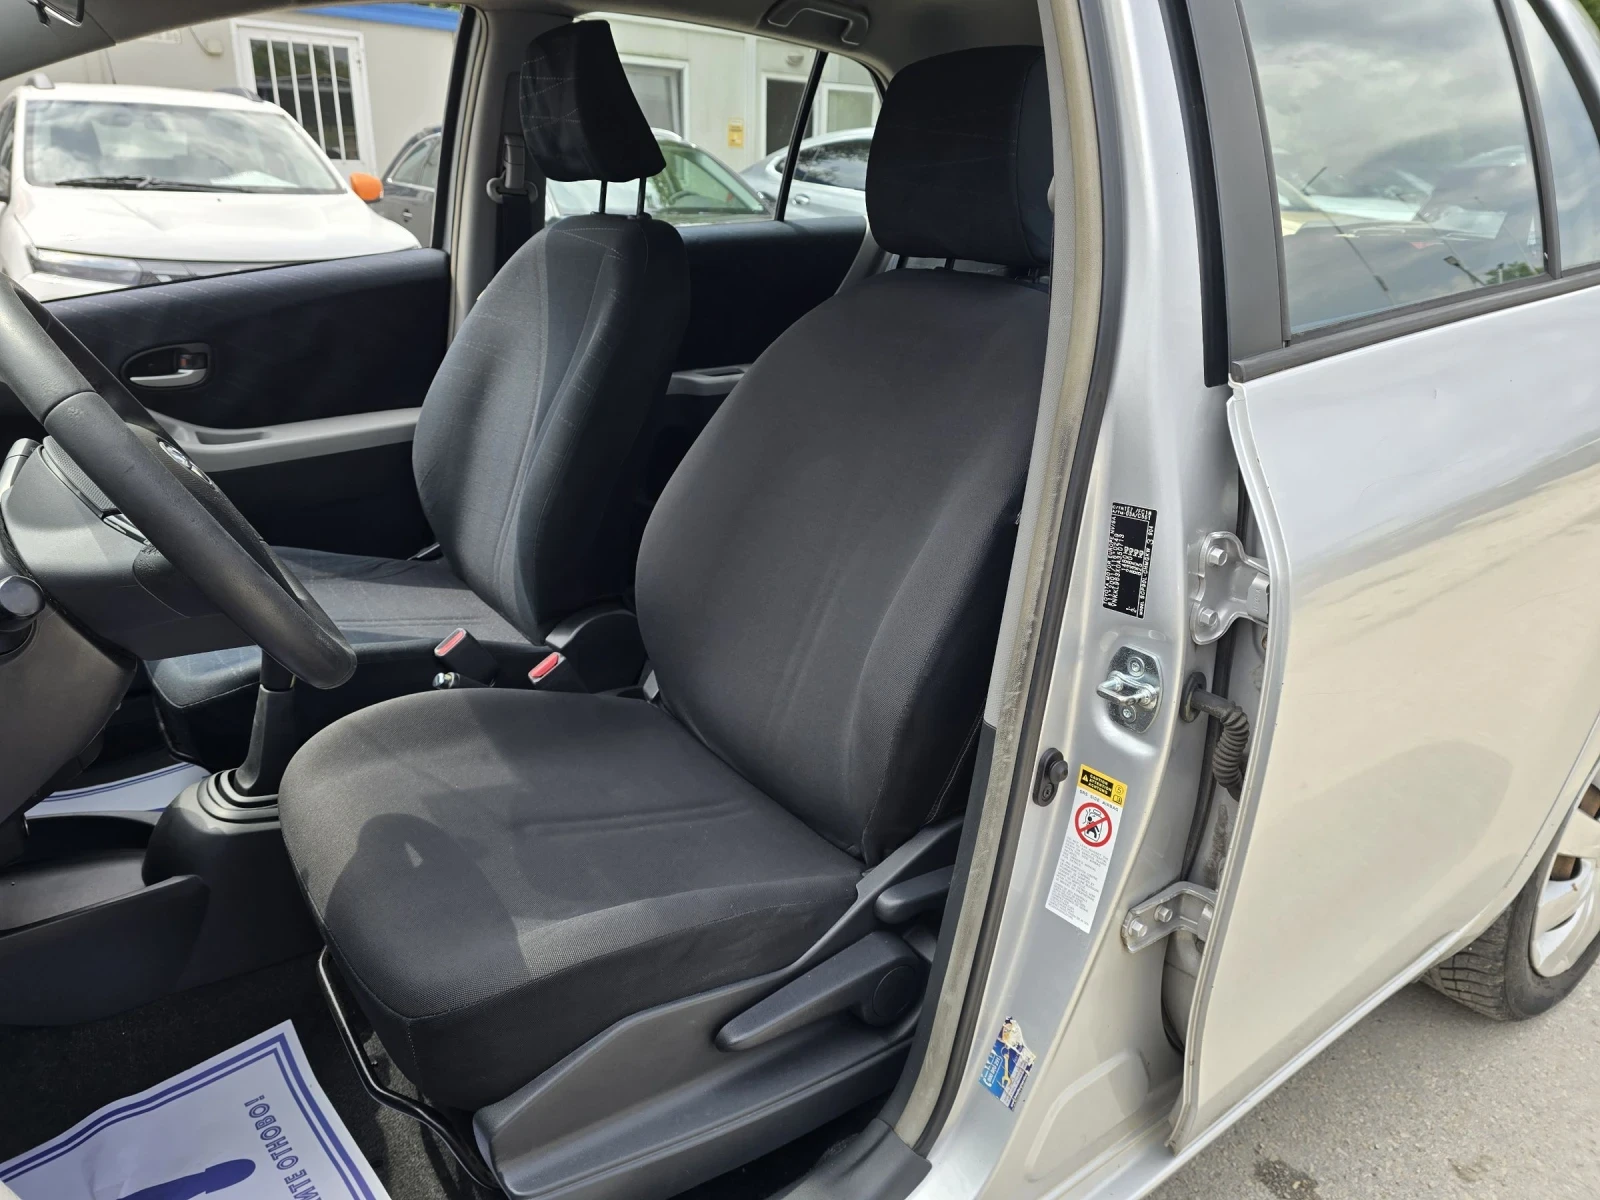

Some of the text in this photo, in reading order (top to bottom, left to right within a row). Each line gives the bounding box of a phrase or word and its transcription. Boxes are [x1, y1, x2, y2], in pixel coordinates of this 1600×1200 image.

[1089, 778, 1112, 792] ATTENTION
[1090, 774, 1108, 786] CAUTION
[1088, 782, 1108, 795] ACHTUNG
[1102, 801, 1119, 812] AIRBAG
[244, 1094, 298, 1170] ОТНОВО!
